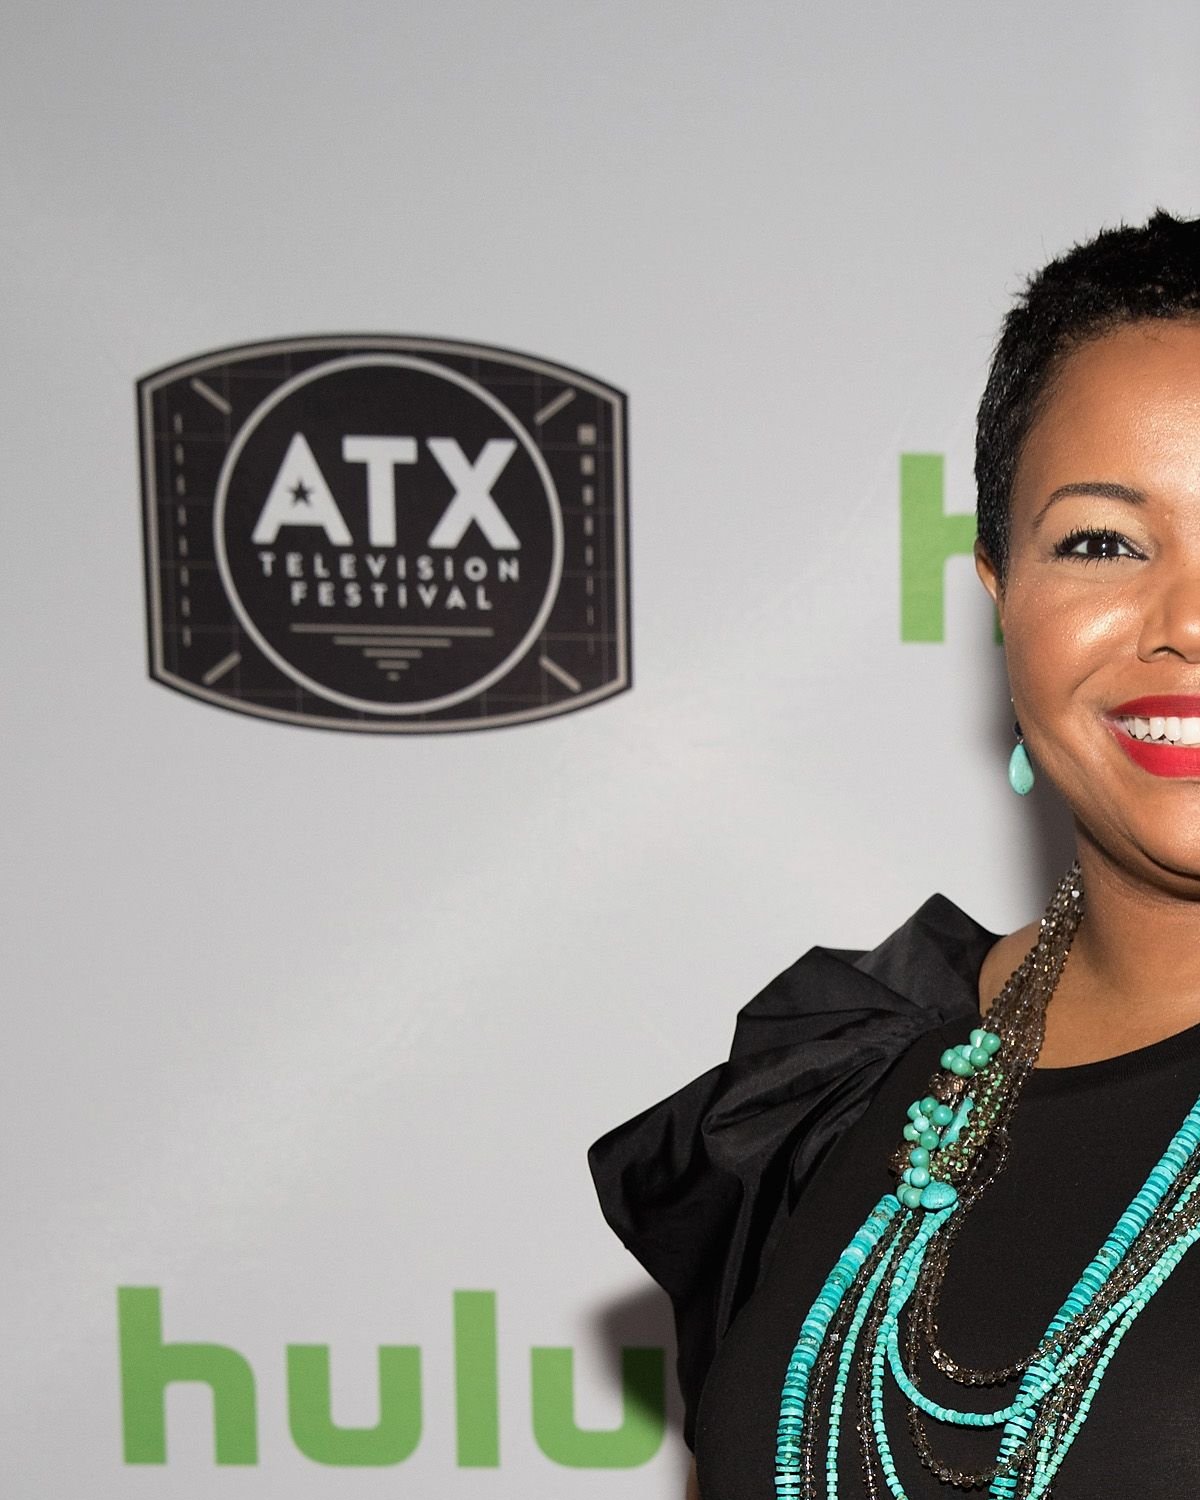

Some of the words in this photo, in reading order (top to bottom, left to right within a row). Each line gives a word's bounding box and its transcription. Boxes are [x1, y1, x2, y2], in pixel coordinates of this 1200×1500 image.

[251, 432, 522, 550] ATX
[258, 551, 520, 582] TELEVISION
[290, 580, 493, 611] FESTIVAL
[116, 1285, 667, 1470] hulu
